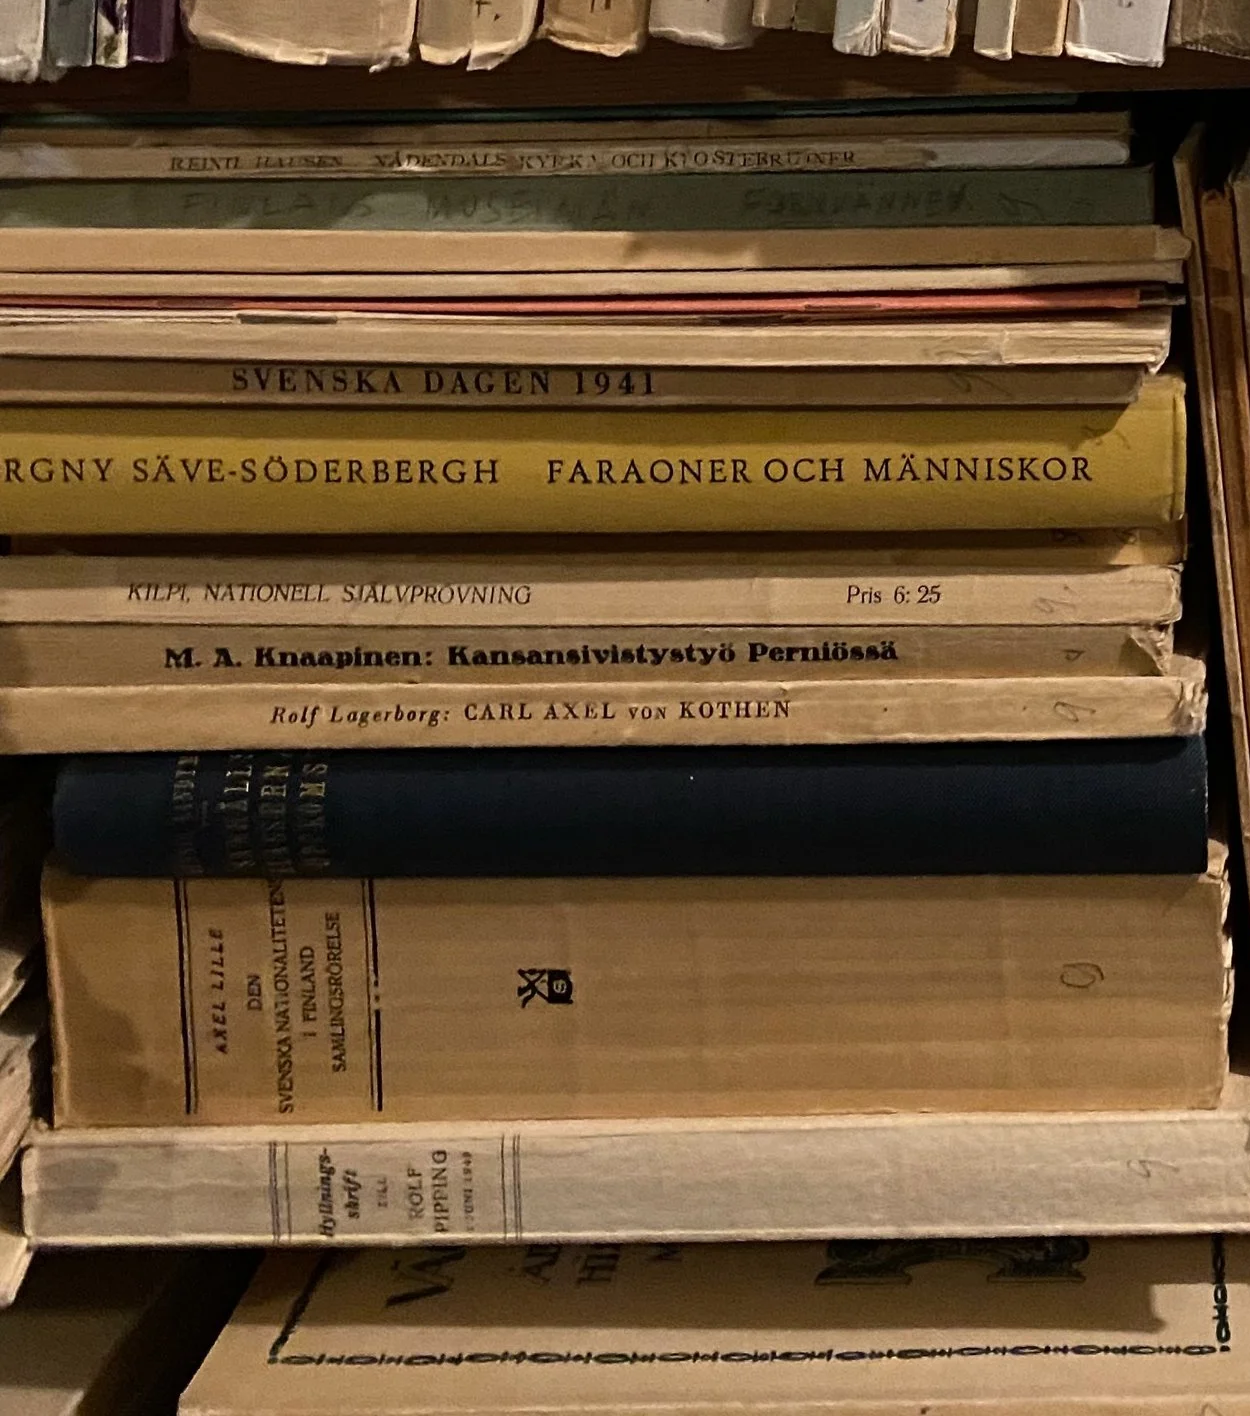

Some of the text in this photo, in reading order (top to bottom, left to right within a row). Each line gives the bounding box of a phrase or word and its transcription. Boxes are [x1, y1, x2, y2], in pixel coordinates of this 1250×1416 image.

[611, 149, 656, 168] OCH
[232, 365, 657, 396] SVENSKA DAGEN 1941
[3, 452, 1094, 485] RGNY SÄVE-SÖDERBERGH FARAONER OCH MÄNNISKOR
[126, 583, 193, 606] KILPI,
[203, 583, 331, 605] NATIONELL
[846, 584, 883, 605] Pris
[916, 584, 942, 605] 25
[164, 639, 899, 670] M. A. Knaapinen: Kansansivistystyö Perniössä
[269, 700, 793, 728] Rolf Lagerborg: CARL AXEL KOTHEN
[245, 974, 264, 1012] DEN
[300, 945, 317, 1026] FINLAND
[214, 996, 230, 1055] AXEL
[275, 1033, 295, 1115] SVENSKA
[342, 1168, 362, 1219] skrift
[407, 1167, 425, 1221] ROLF
[431, 1149, 449, 1233] PIPPING
